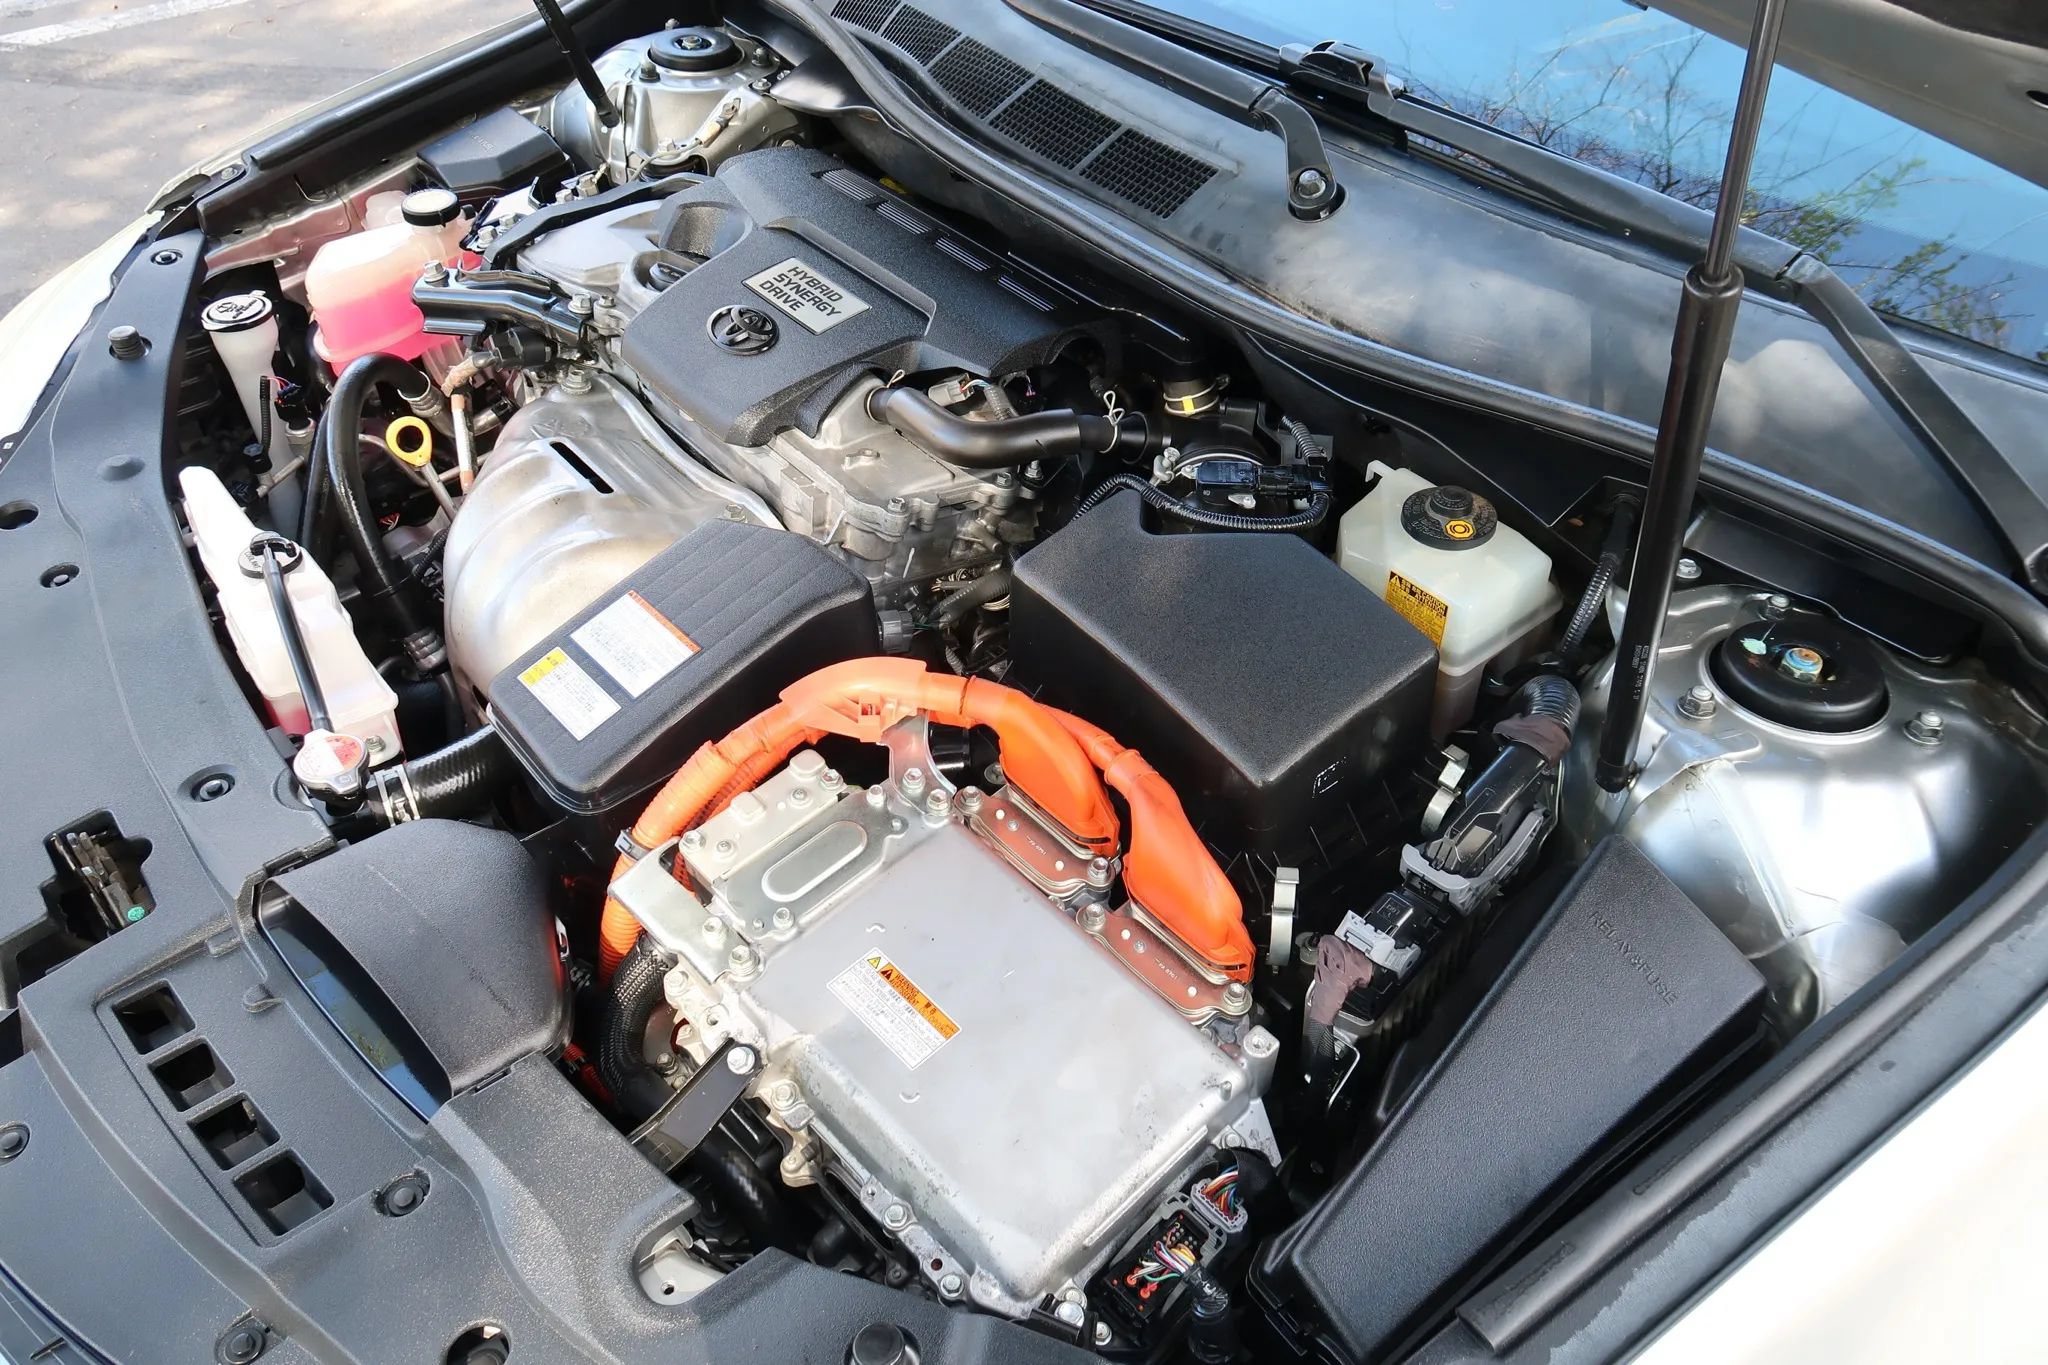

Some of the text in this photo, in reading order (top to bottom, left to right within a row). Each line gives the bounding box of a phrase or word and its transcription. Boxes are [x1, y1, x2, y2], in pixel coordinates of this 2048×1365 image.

[759, 280, 805, 312] DRIVE
[772, 273, 842, 317] SYNERGY
[787, 266, 843, 302] HYBRID
[1421, 590, 1446, 610] CAUTION
[1588, 910, 1679, 1007] RELAY&FUSE
